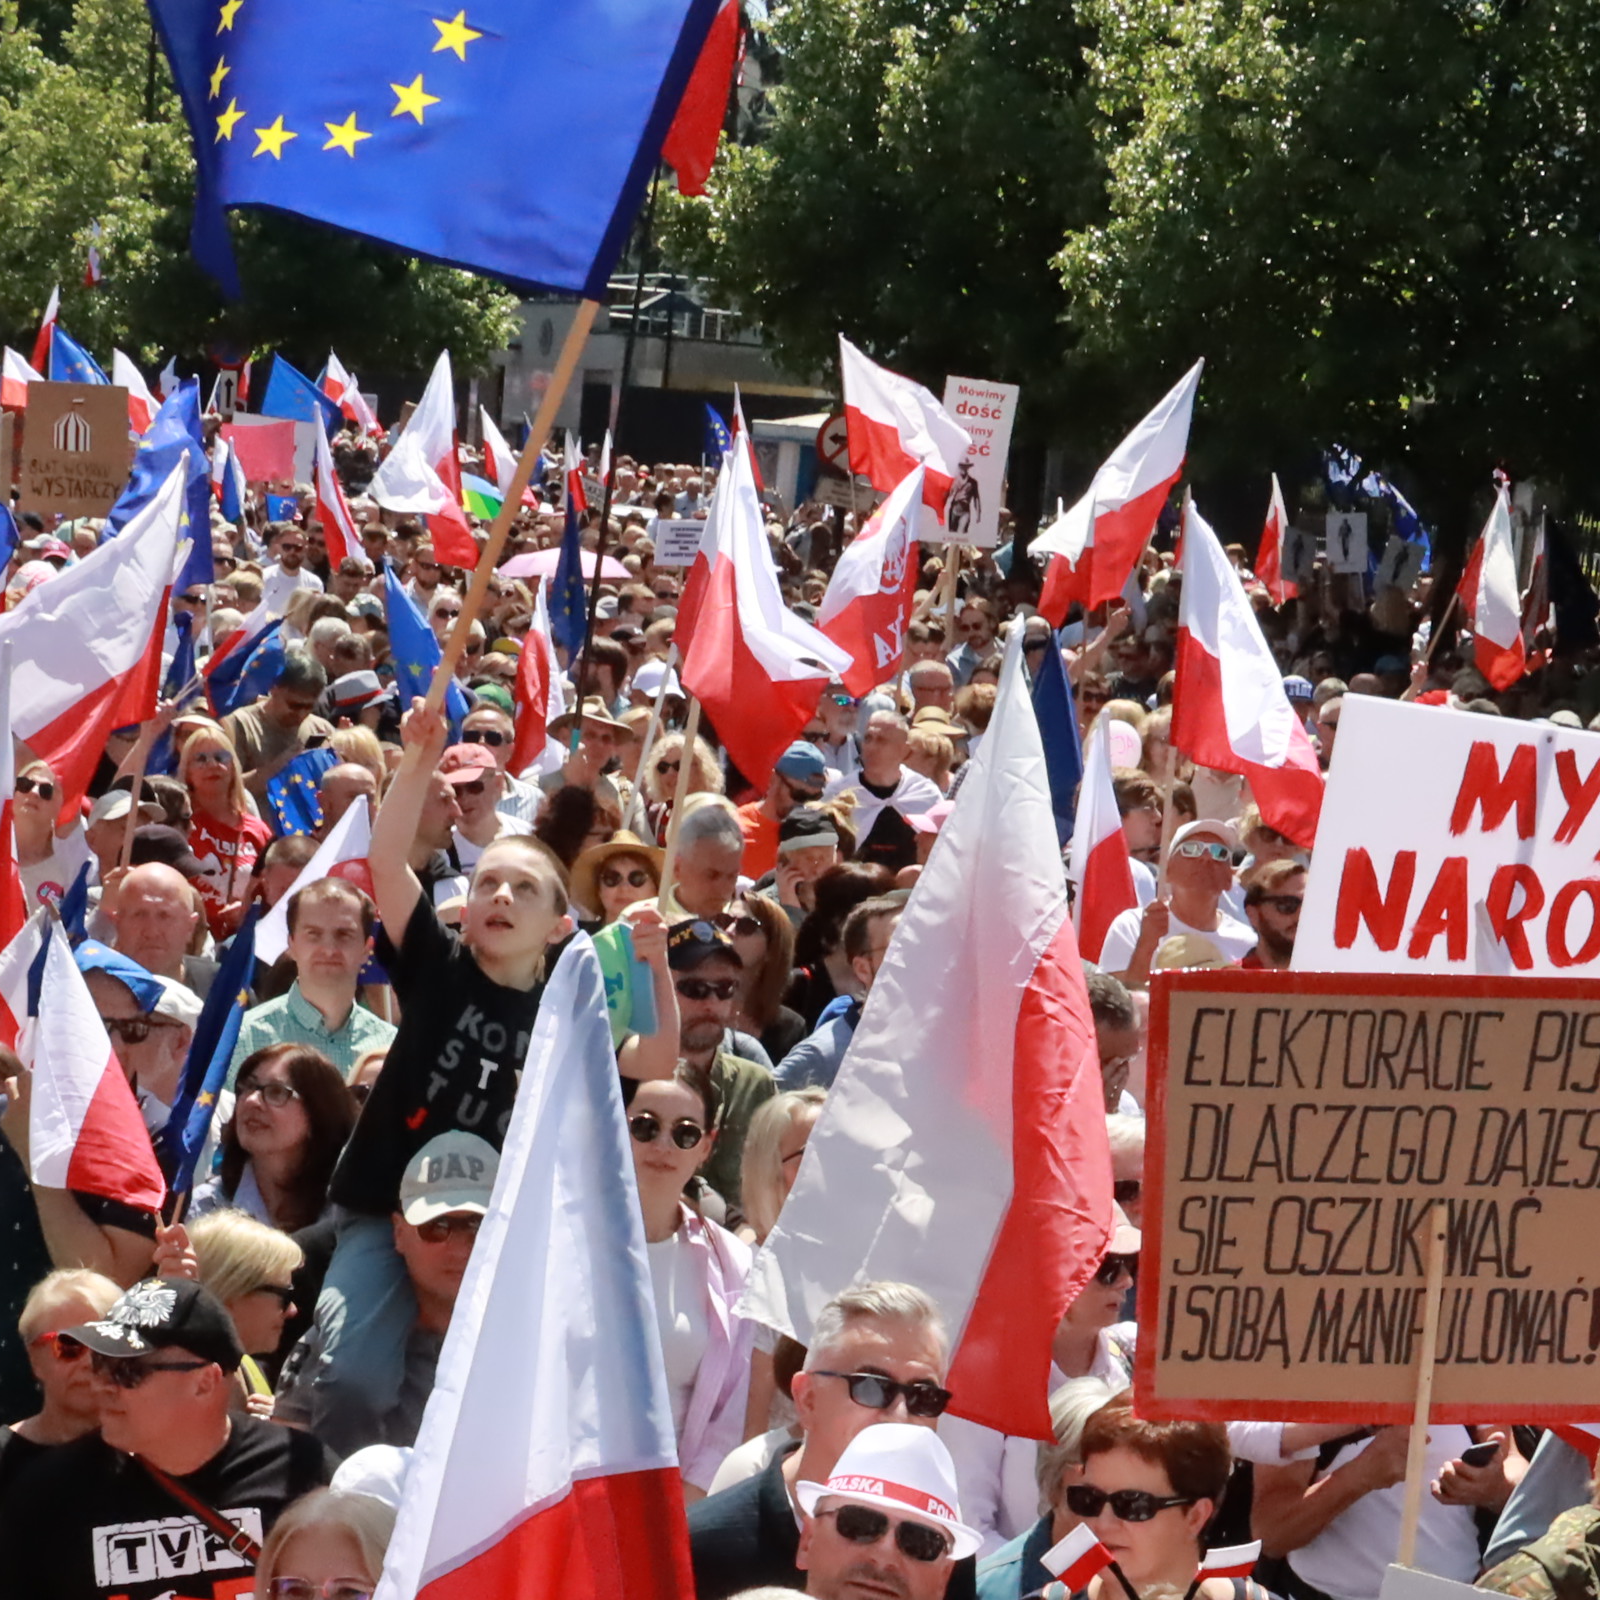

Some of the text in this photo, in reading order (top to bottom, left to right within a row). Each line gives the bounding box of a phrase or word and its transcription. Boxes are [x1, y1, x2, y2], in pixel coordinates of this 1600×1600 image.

[956, 400, 1002, 420] dość
[967, 440, 991, 456] ść
[31, 476, 121, 499] WYSTARCZY
[1183, 1008, 1504, 1092] ELEKTORACIE
[1180, 1103, 1457, 1186] DLACZEGO
[426, 1153, 485, 1184] GAP
[1173, 1190, 1542, 1280] SIĘ OSZUKWAĆ
[1181, 1285, 1290, 1370] SOBĄ
[827, 1476, 959, 1522] POLSKA POL
